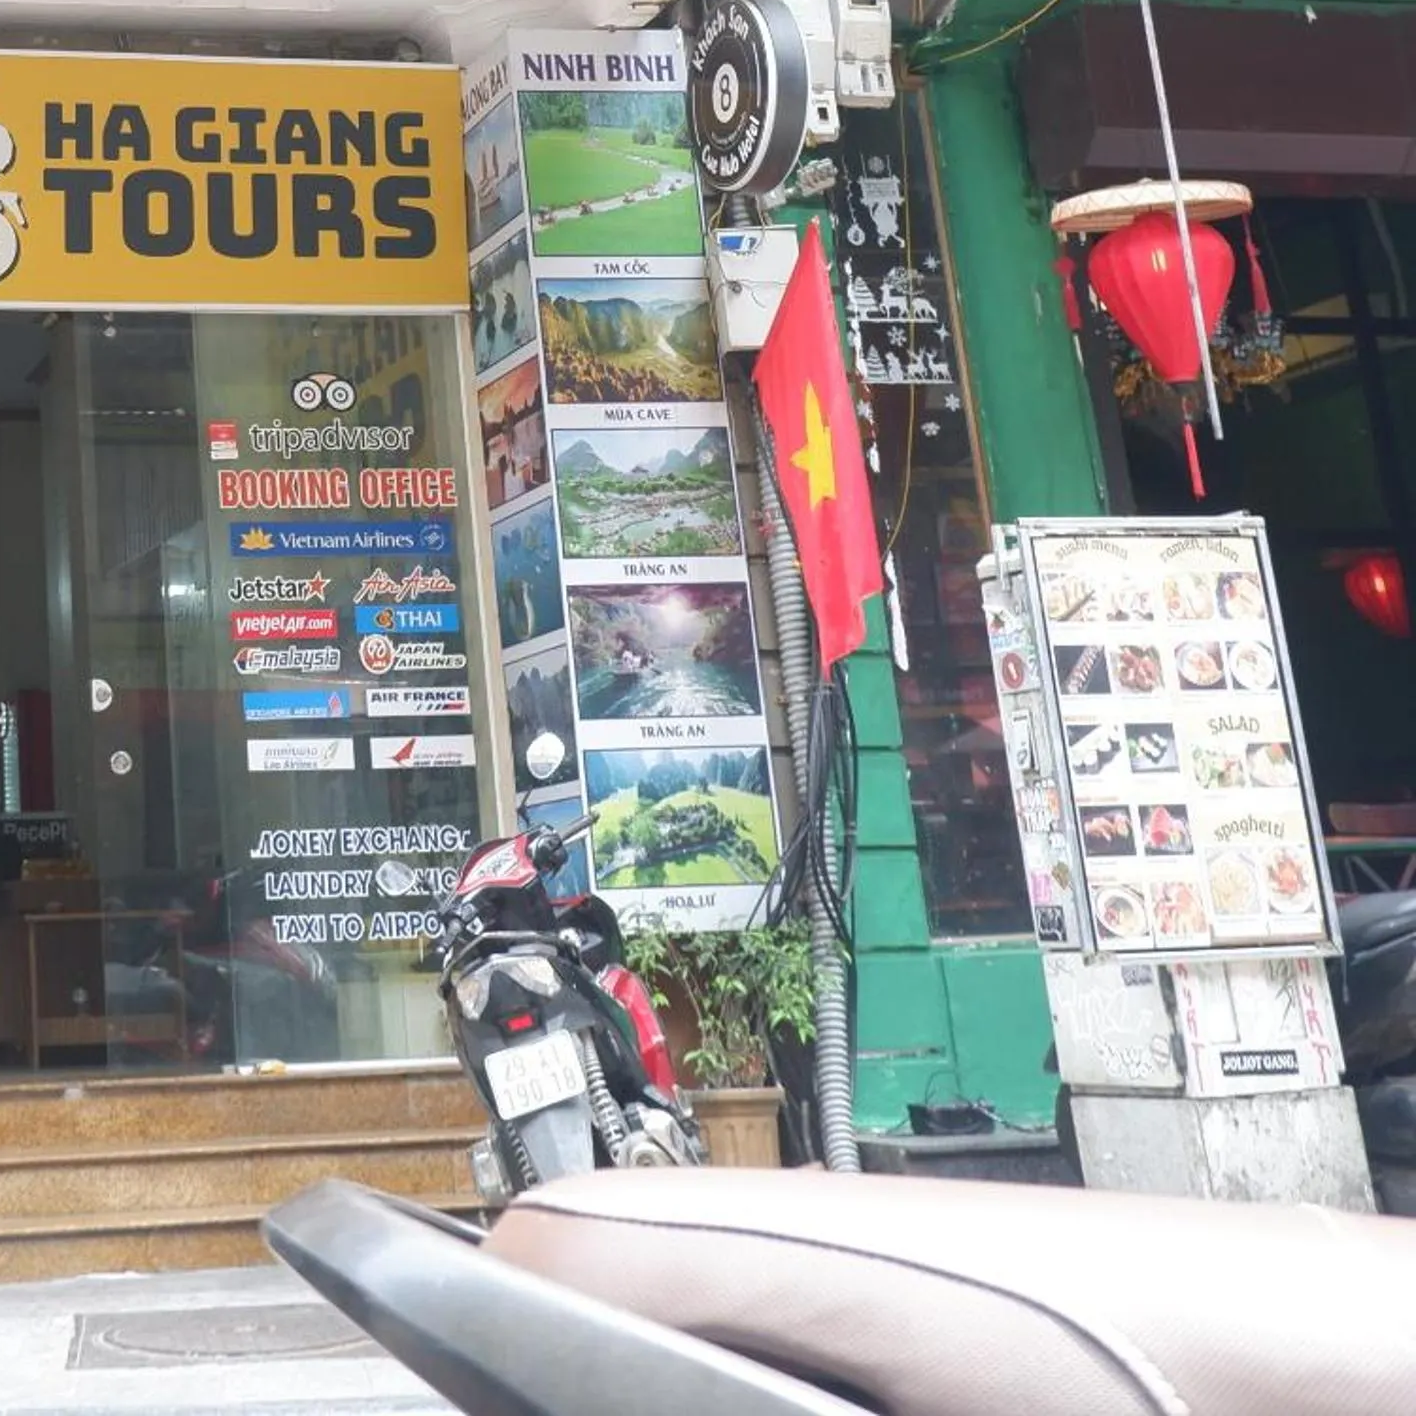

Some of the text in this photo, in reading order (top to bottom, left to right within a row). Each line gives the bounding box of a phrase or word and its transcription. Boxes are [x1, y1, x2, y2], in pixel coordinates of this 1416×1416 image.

[523, 53, 675, 82] NINH BINH
[720, 74, 732, 112] 8
[44, 103, 430, 168] HA GIANG
[43, 168, 437, 260] TOURS
[594, 263, 620, 274] TAM
[249, 418, 413, 459] tripadvisor
[218, 468, 457, 508] BOOKING OFFICE
[279, 532, 414, 549] Vietnam Airlines
[669, 564, 687, 576] AN
[229, 575, 310, 602] Jetstar
[397, 610, 442, 627] THAI
[263, 646, 340, 671] malaysia
[398, 643, 443, 655] JAPAN
[398, 656, 465, 668] AIRLINES
[371, 691, 465, 702] AIR FRANCE
[687, 724, 705, 737] AN
[1208, 714, 1261, 735] SALAD
[265, 871, 372, 900] LAUNDRY
[273, 912, 445, 942] TAXI TO AIRPO
